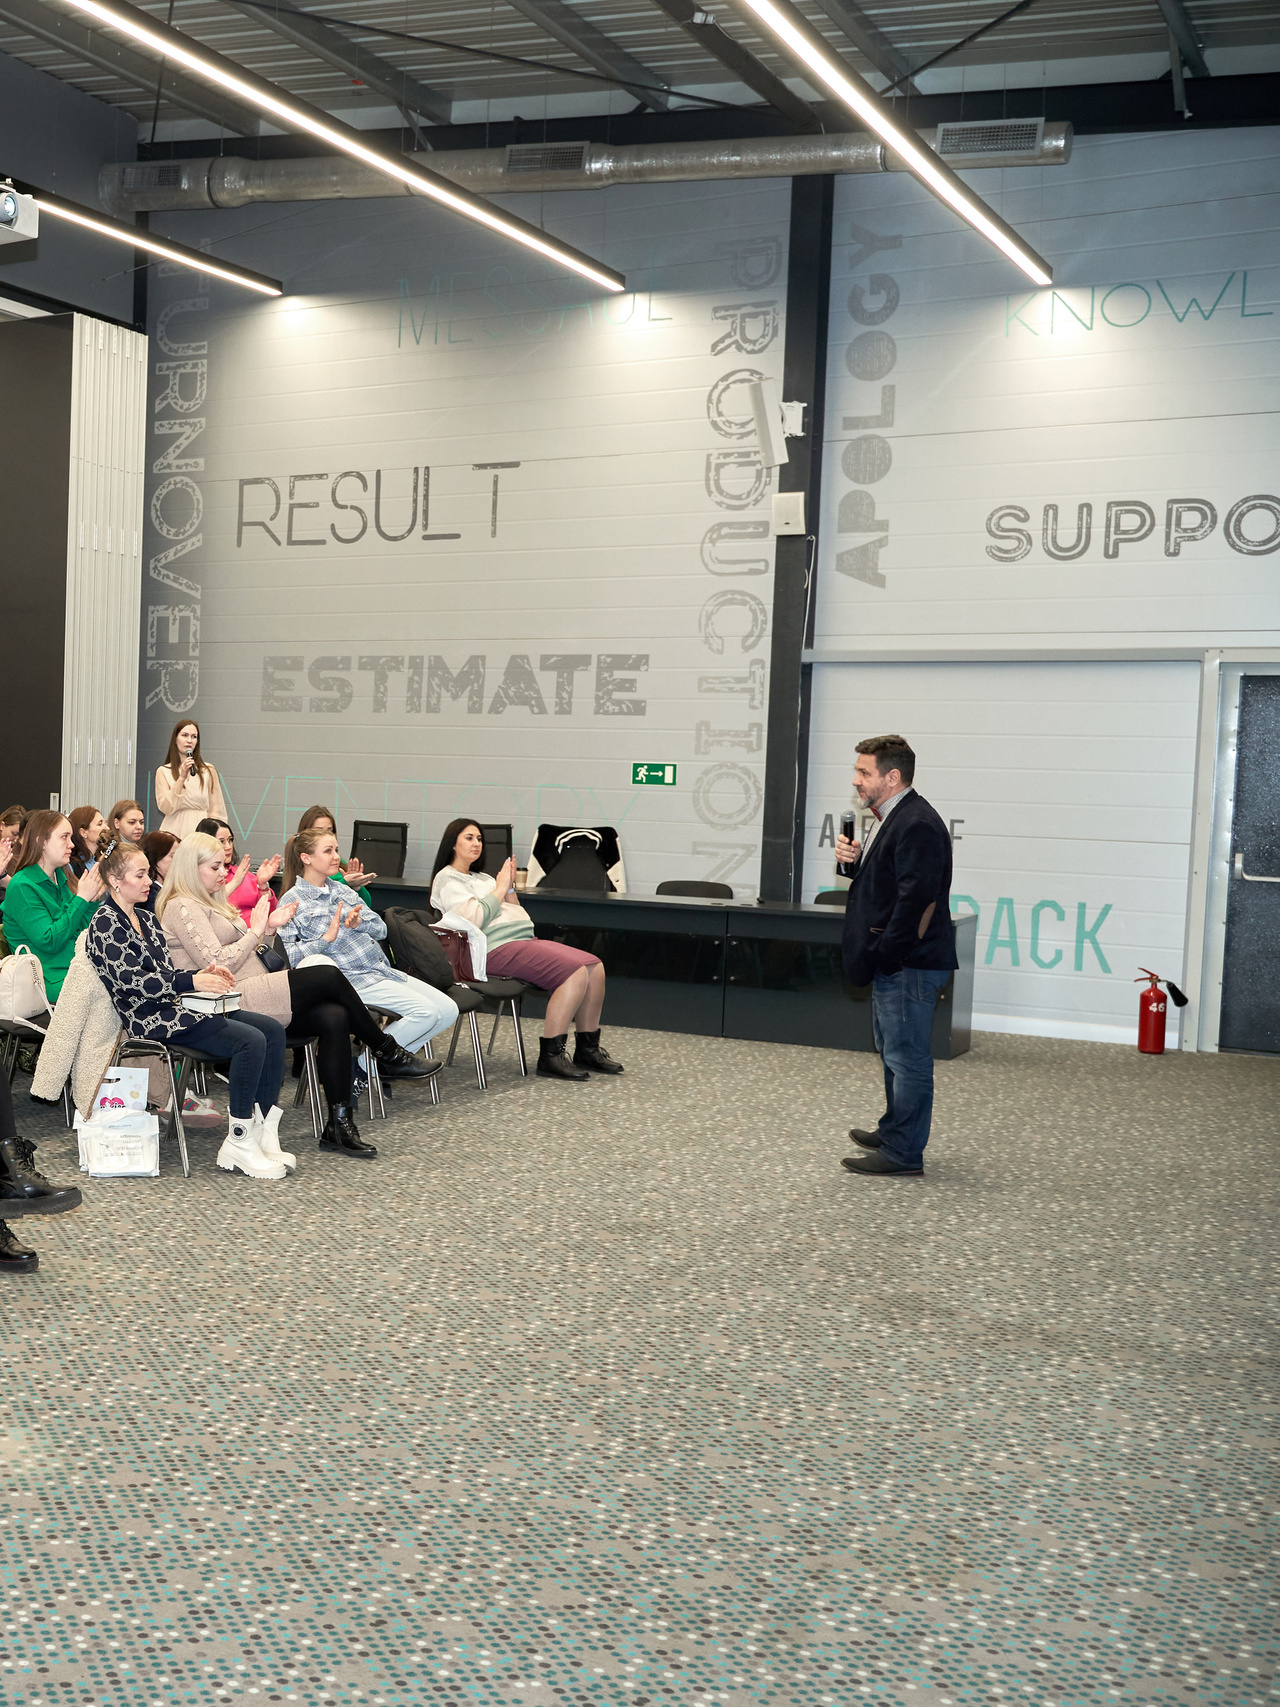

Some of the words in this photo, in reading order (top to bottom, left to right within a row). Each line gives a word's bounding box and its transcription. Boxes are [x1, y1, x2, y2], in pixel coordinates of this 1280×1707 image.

[1005, 270, 1274, 338] KNOWL
[835, 222, 903, 589] APOLOGY
[236, 460, 522, 549] RESULT
[985, 493, 1280, 563] SUPPO
[691, 234, 783, 900] PRODUCTION
[261, 652, 650, 717] ESTIMATE
[146, 771, 642, 850] IVENTORY
[1148, 1002, 1166, 1013] 46
